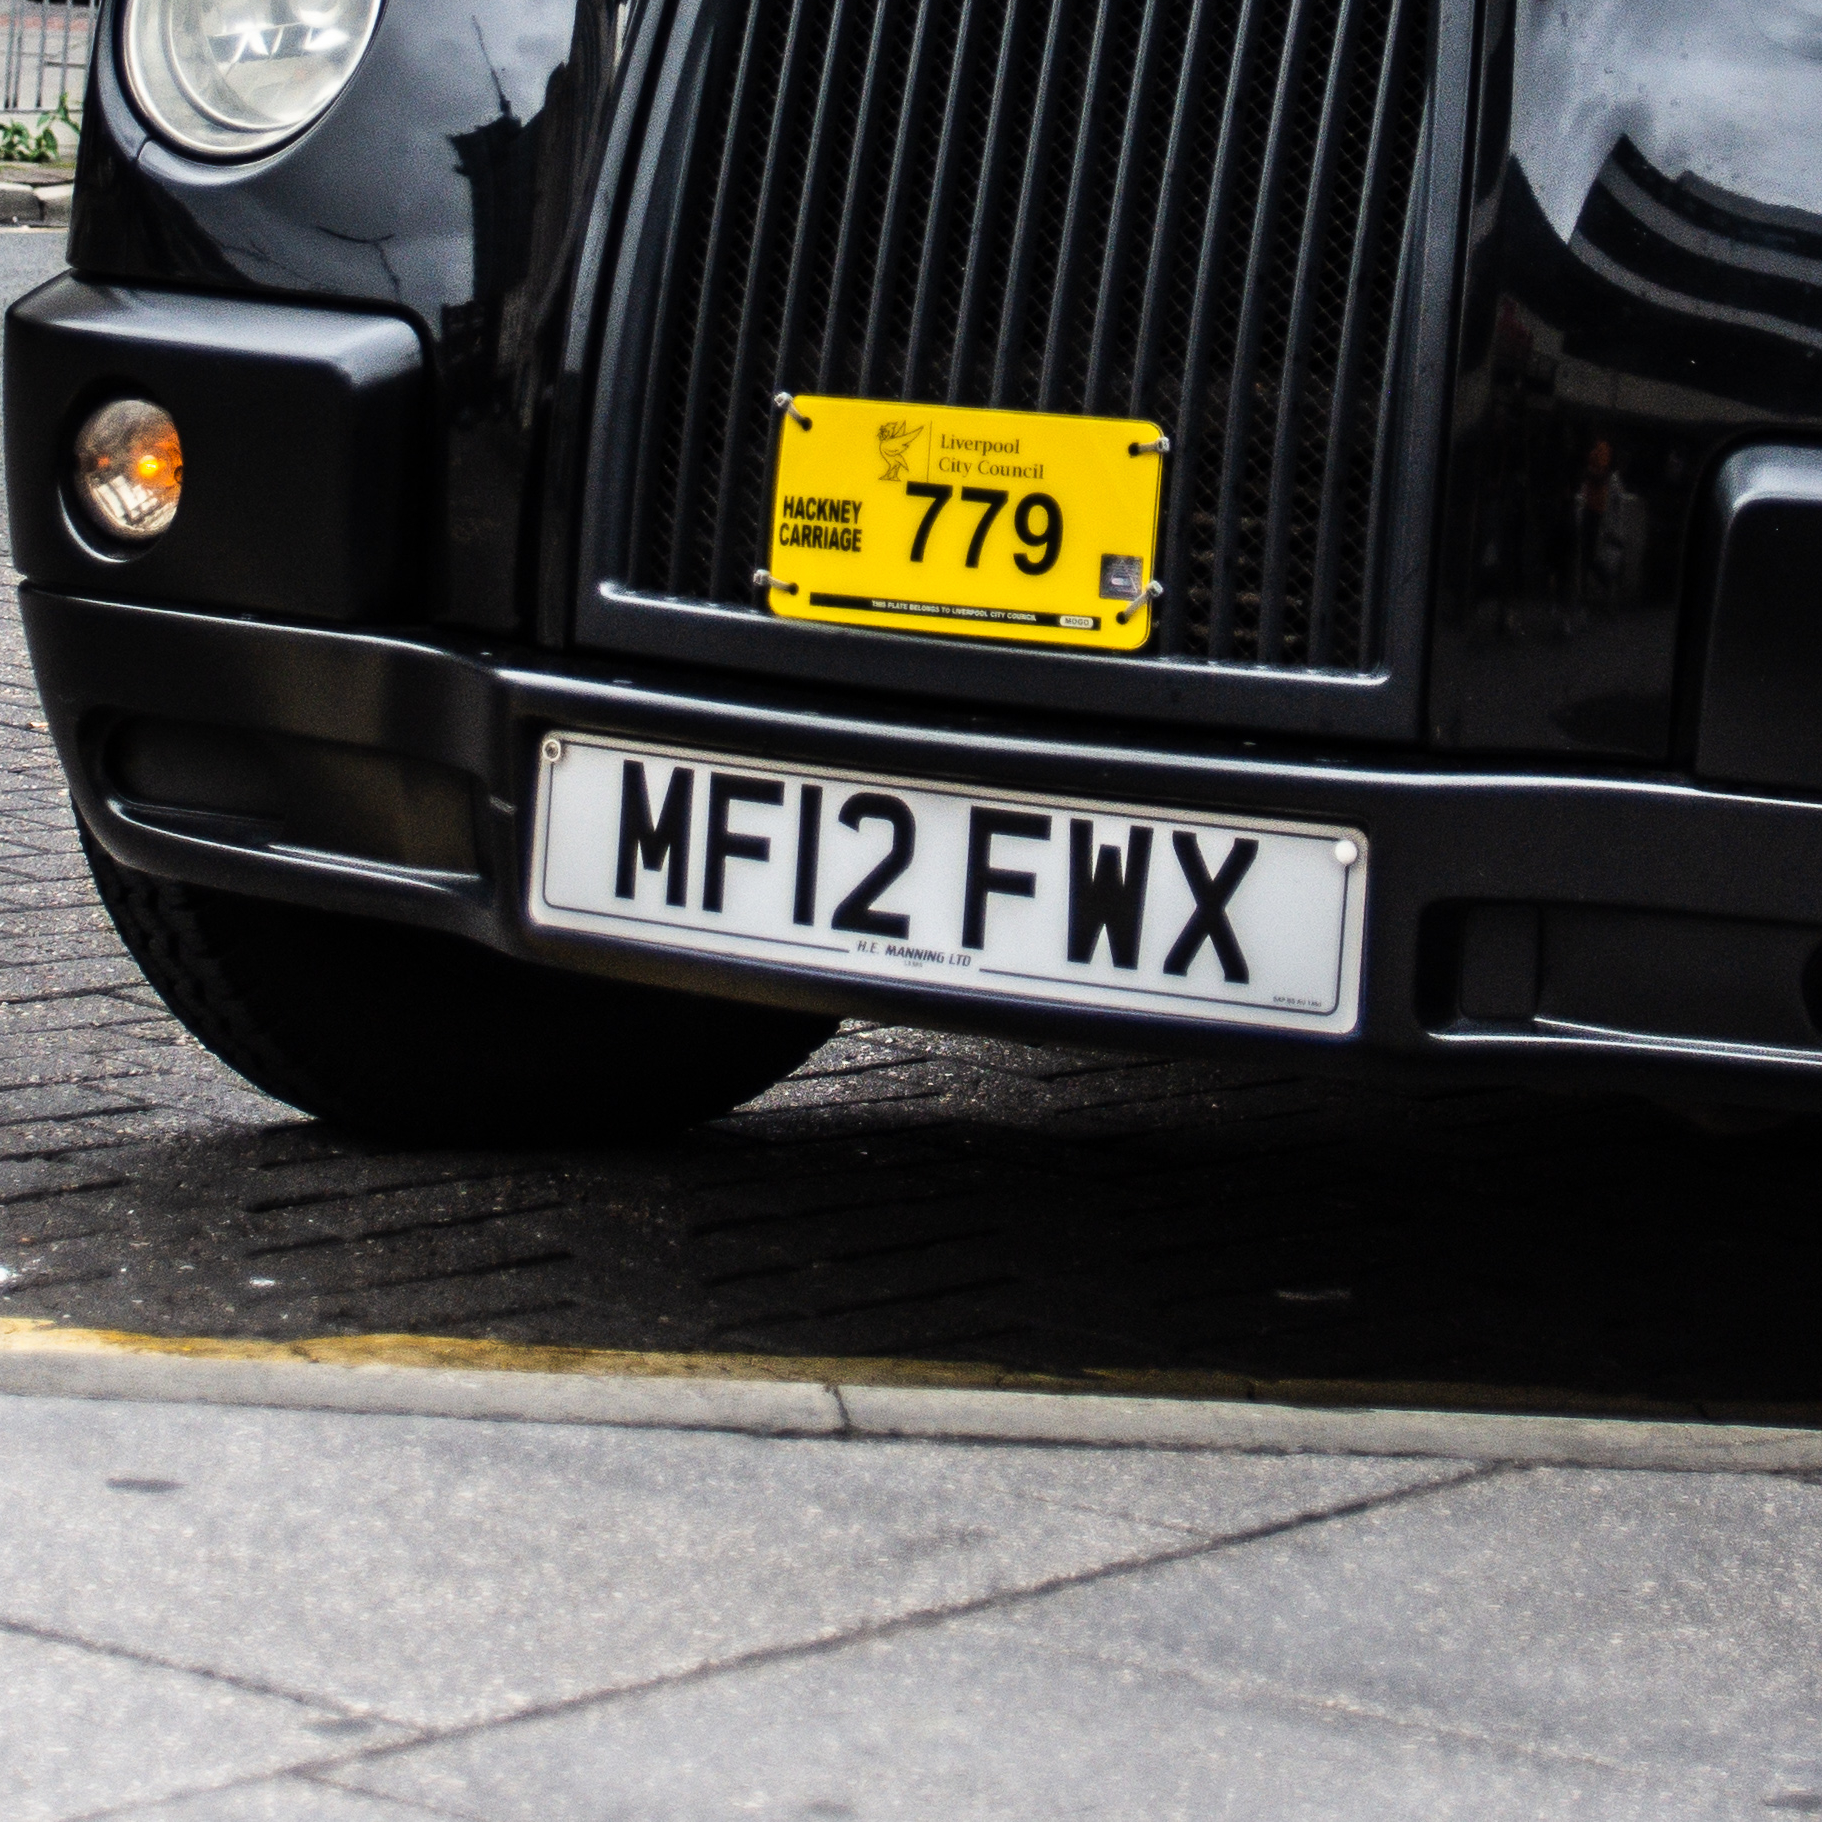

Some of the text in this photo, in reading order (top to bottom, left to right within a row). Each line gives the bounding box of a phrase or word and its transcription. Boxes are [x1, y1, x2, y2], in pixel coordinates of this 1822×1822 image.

[940, 433, 1020, 456] Liverpool
[938, 456, 1045, 479] City Council
[782, 495, 863, 524] HACKNEY
[779, 523, 862, 553] CARRIAGE
[905, 480, 1064, 576] 779
[871, 600, 1037, 621] THIS PLATE BELONGS TO LIVERPOOL CITY COUNCIL
[614, 759, 1259, 984] MF12 FWX
[885, 944, 945, 963] MANNING
[948, 953, 972, 967] LTD
